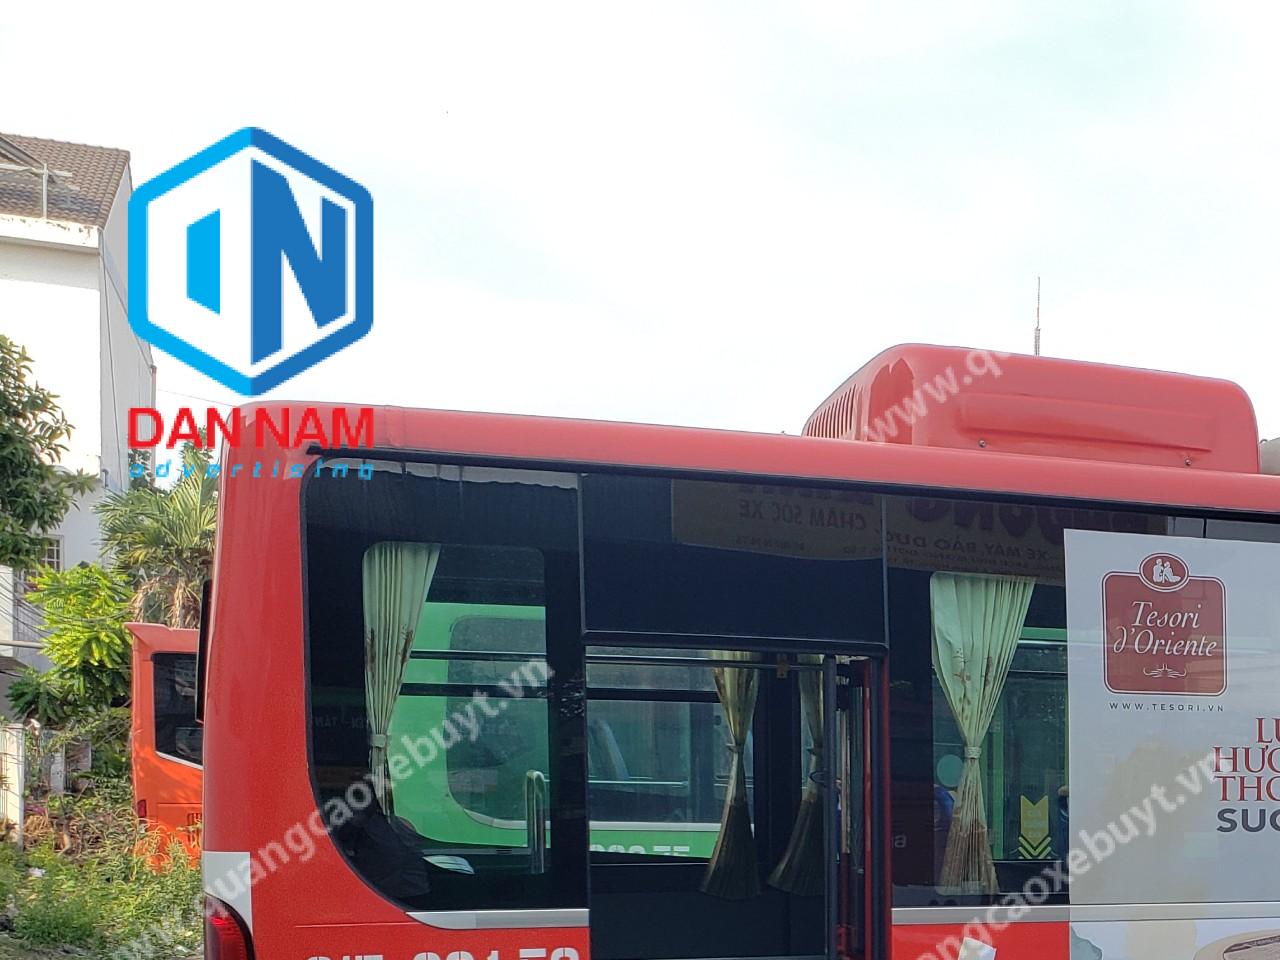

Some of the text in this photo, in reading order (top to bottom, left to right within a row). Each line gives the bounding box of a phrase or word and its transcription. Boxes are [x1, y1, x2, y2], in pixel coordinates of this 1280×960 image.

[1131, 600, 1201, 629] Tesori
[1112, 625, 1218, 657] d'Oriente
[1109, 701, 1224, 712] WWW.TESORI.VN
